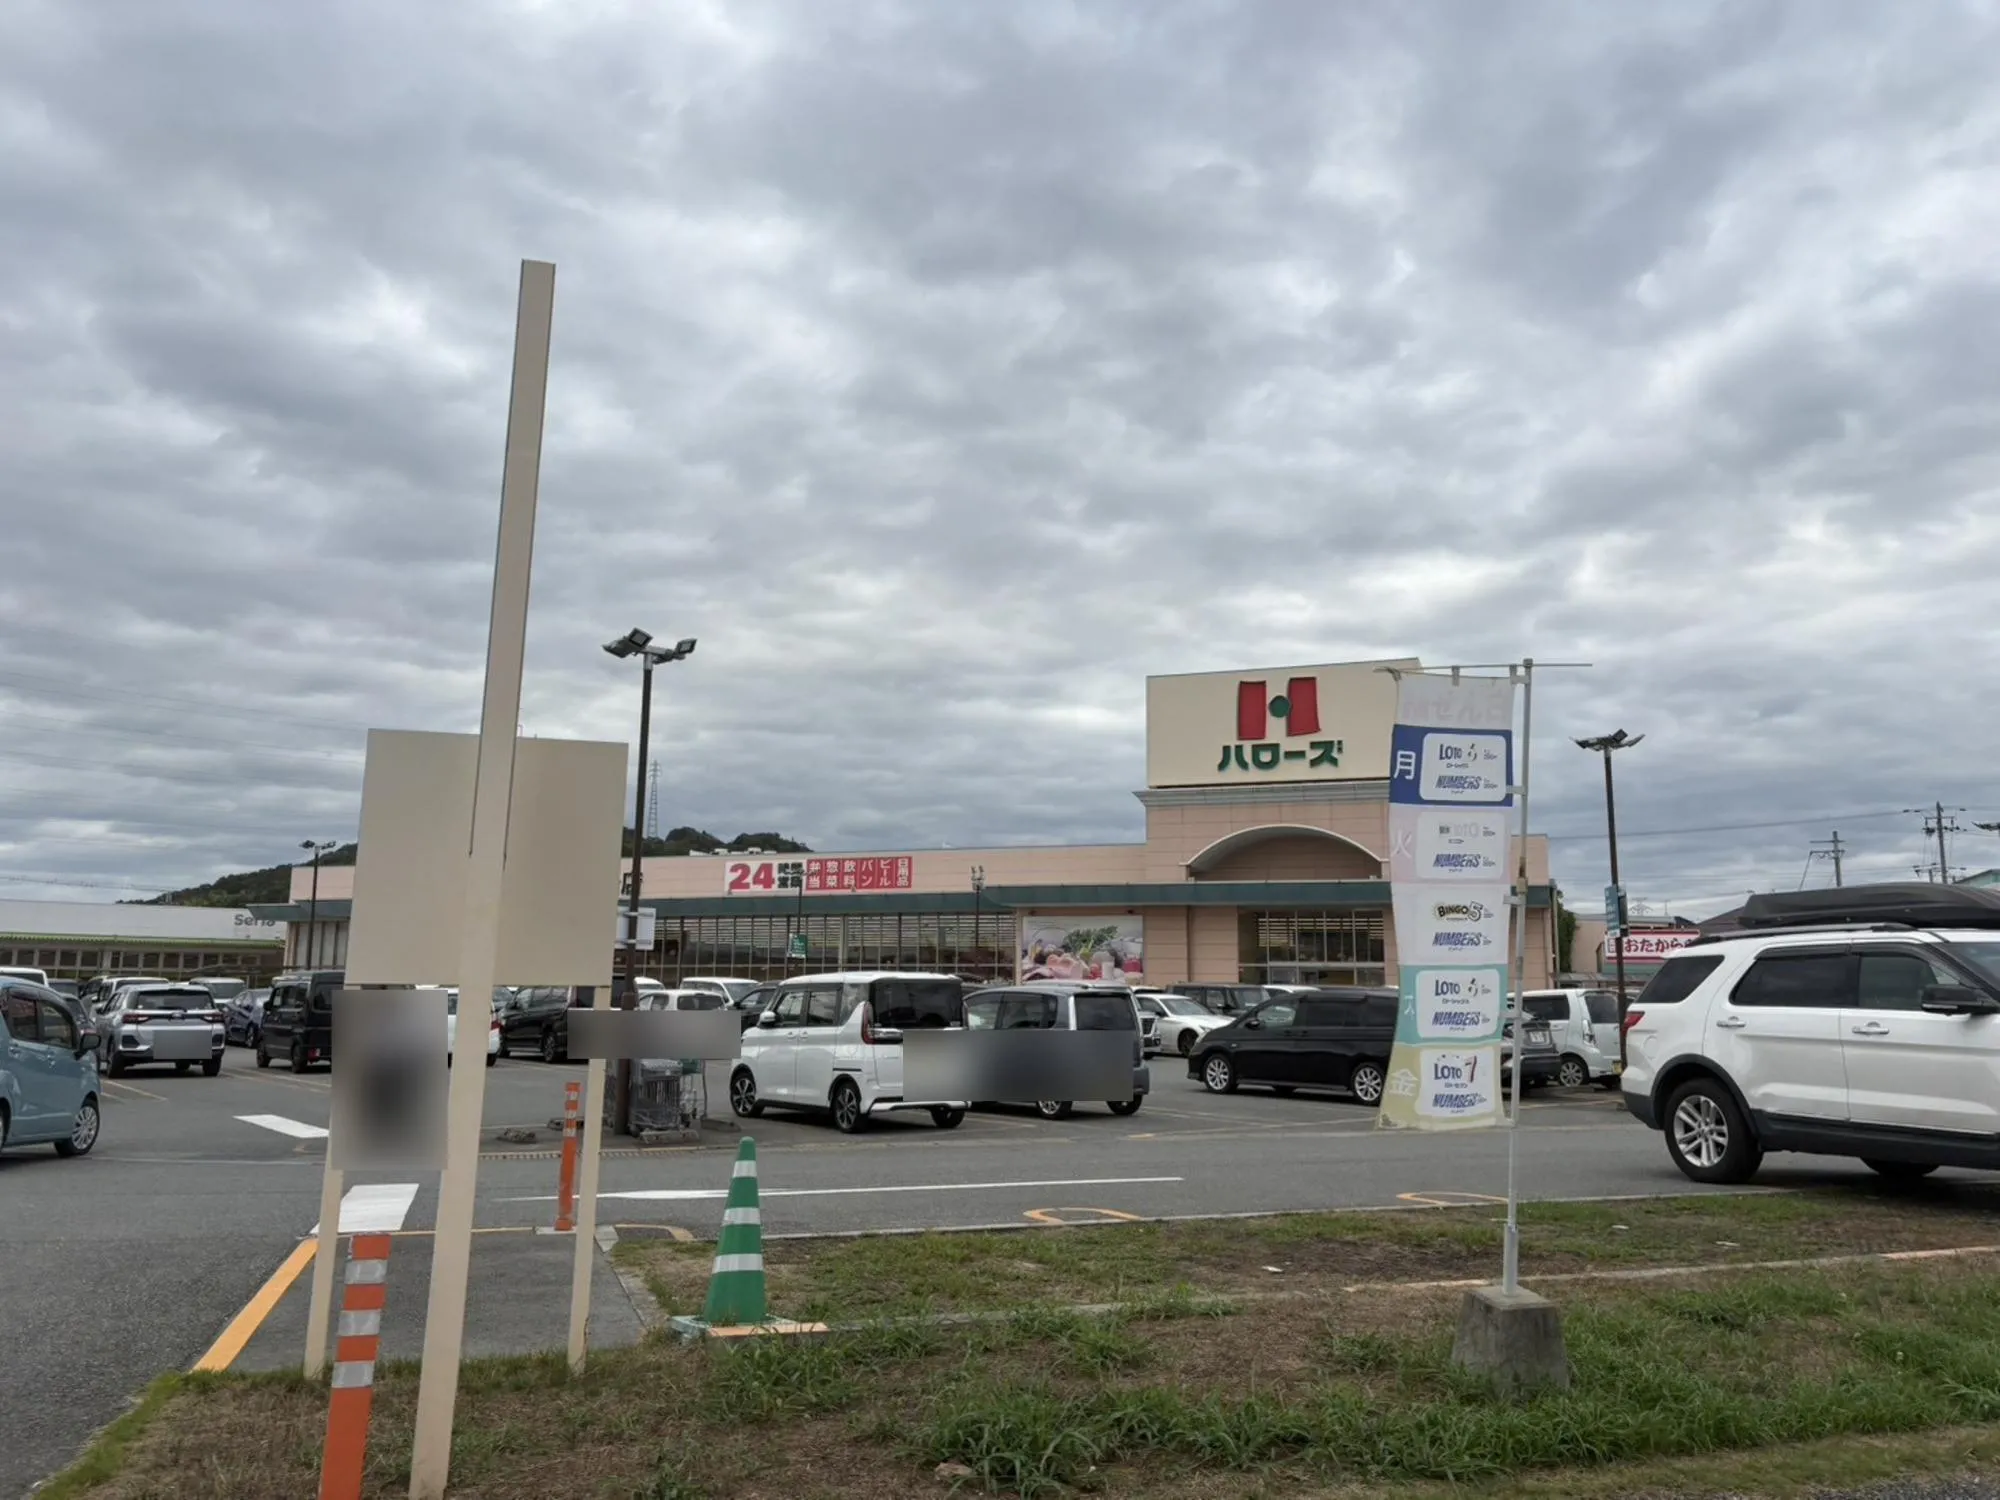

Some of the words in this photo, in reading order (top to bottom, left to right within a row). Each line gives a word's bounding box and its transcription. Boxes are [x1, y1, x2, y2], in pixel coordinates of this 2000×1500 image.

[1217, 740, 1343, 771] ハローズ
[1439, 743, 1463, 760] LOTO
[1393, 750, 1416, 780] 月
[1435, 775, 1482, 790] NUMBERS
[862, 860, 873, 886] パン
[880, 859, 891, 886] ビール
[1433, 854, 1481, 868] NUMBERS
[729, 863, 775, 889] 24
[1432, 932, 1482, 946] NUMBERS
[1435, 979, 1460, 996] LOTO
[1432, 1011, 1480, 1026] NUMBERS
[1434, 1063, 1462, 1080] LOTO
[1464, 1055, 1477, 1083] 7
[1389, 1068, 1419, 1097] 金
